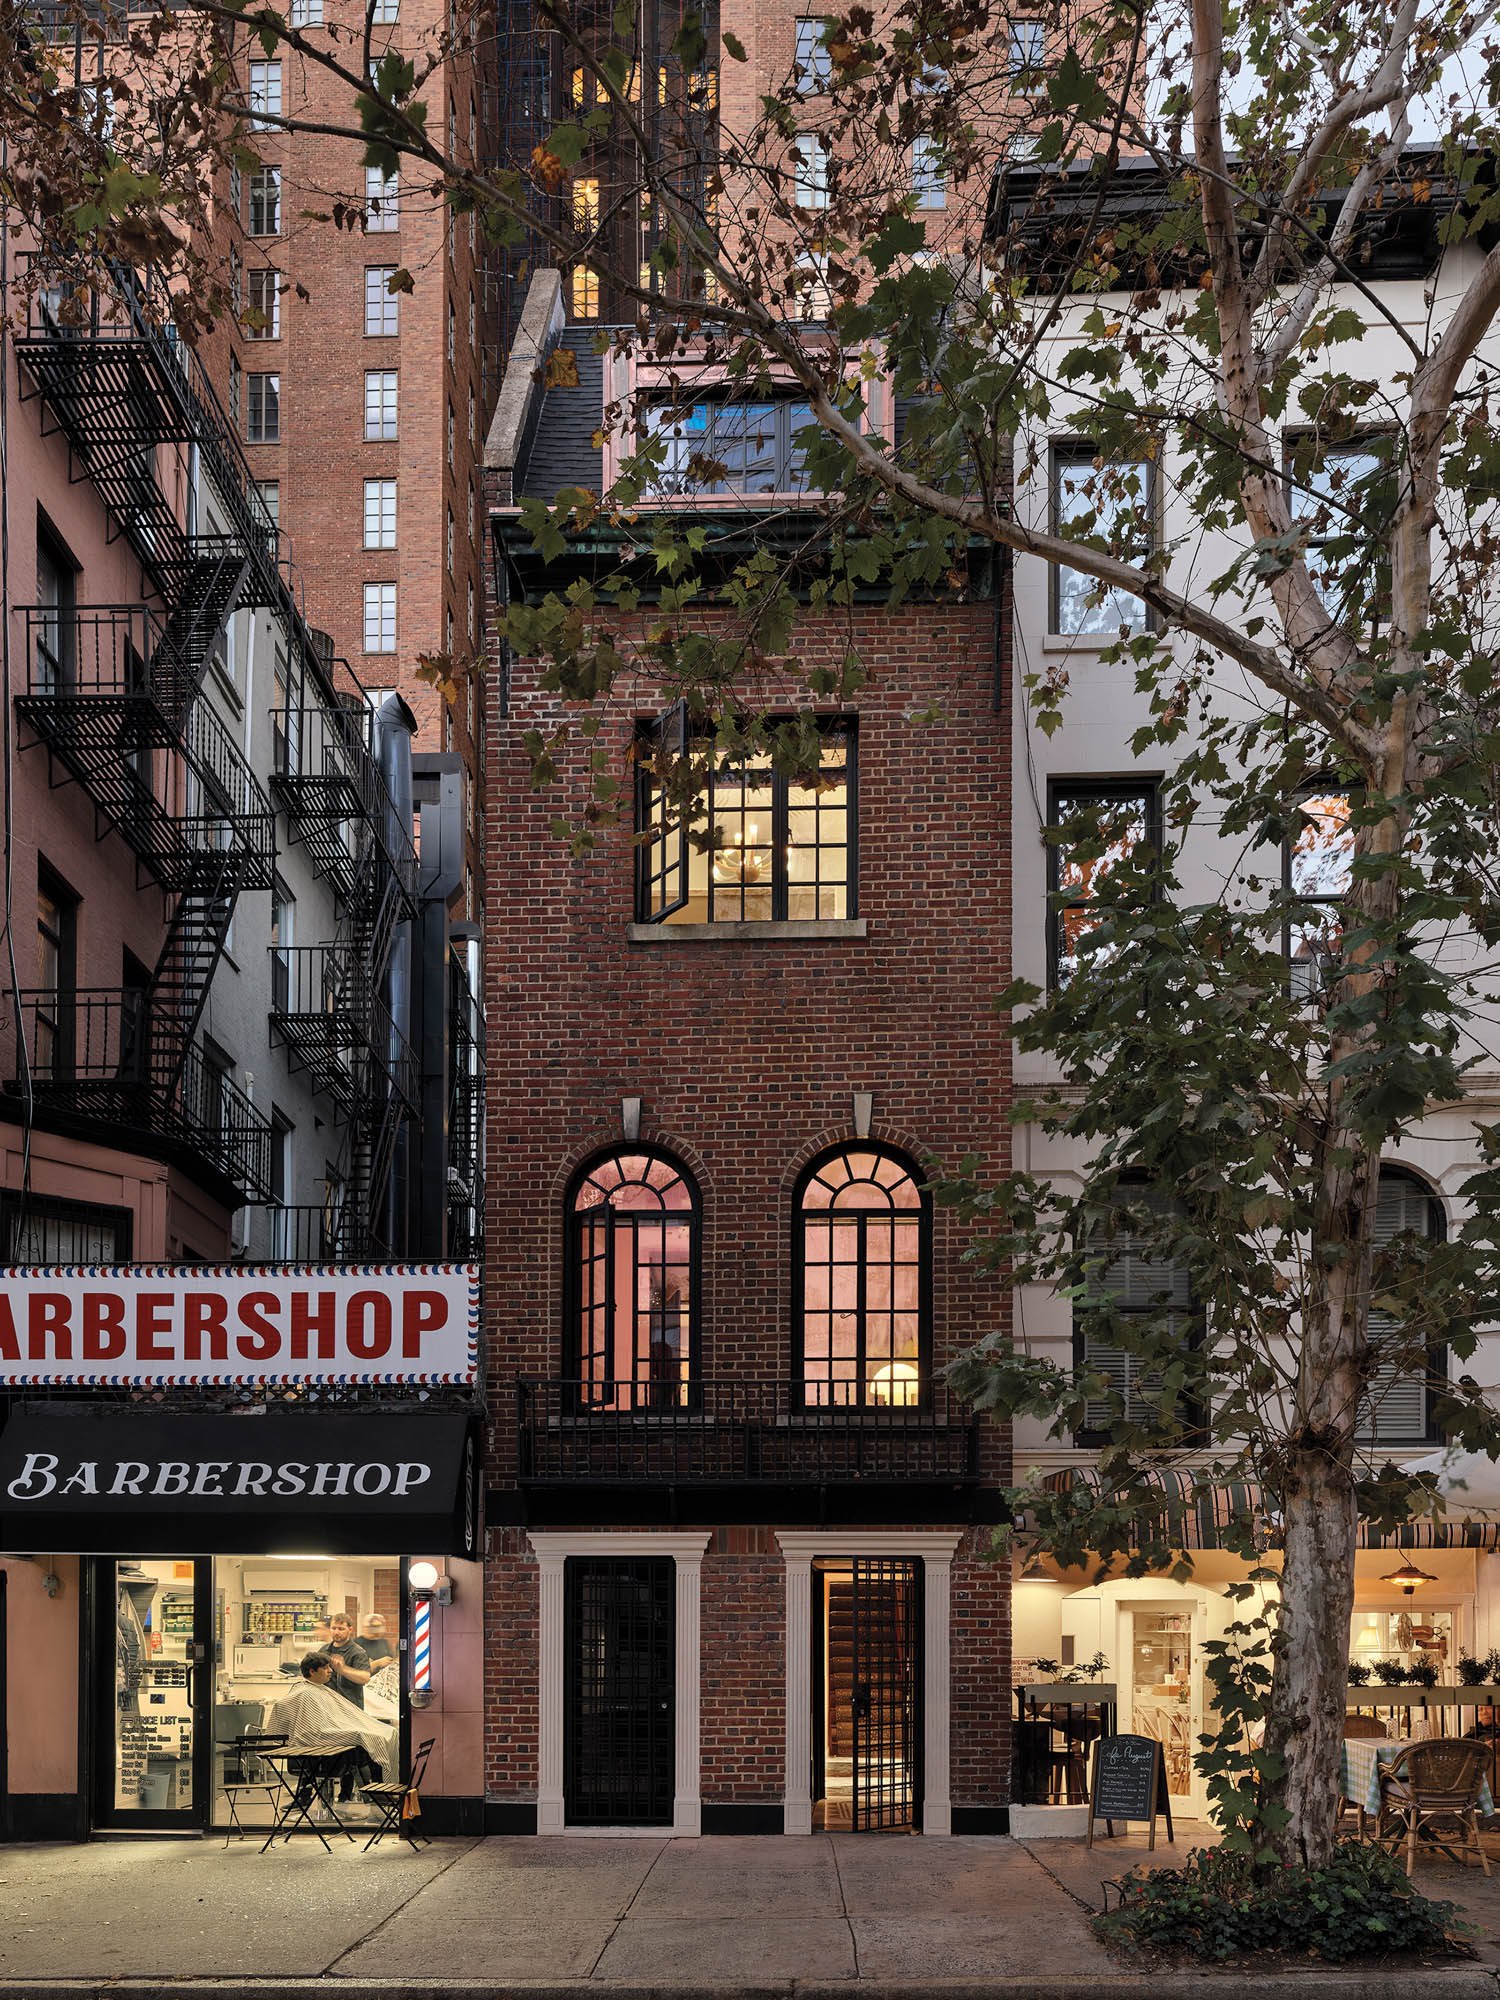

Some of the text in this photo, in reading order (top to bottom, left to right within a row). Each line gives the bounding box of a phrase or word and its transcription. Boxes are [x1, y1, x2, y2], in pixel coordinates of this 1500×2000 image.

[134, 1716, 177, 1725] PRICE LIST
[1124, 1746, 1152, 1763] August
